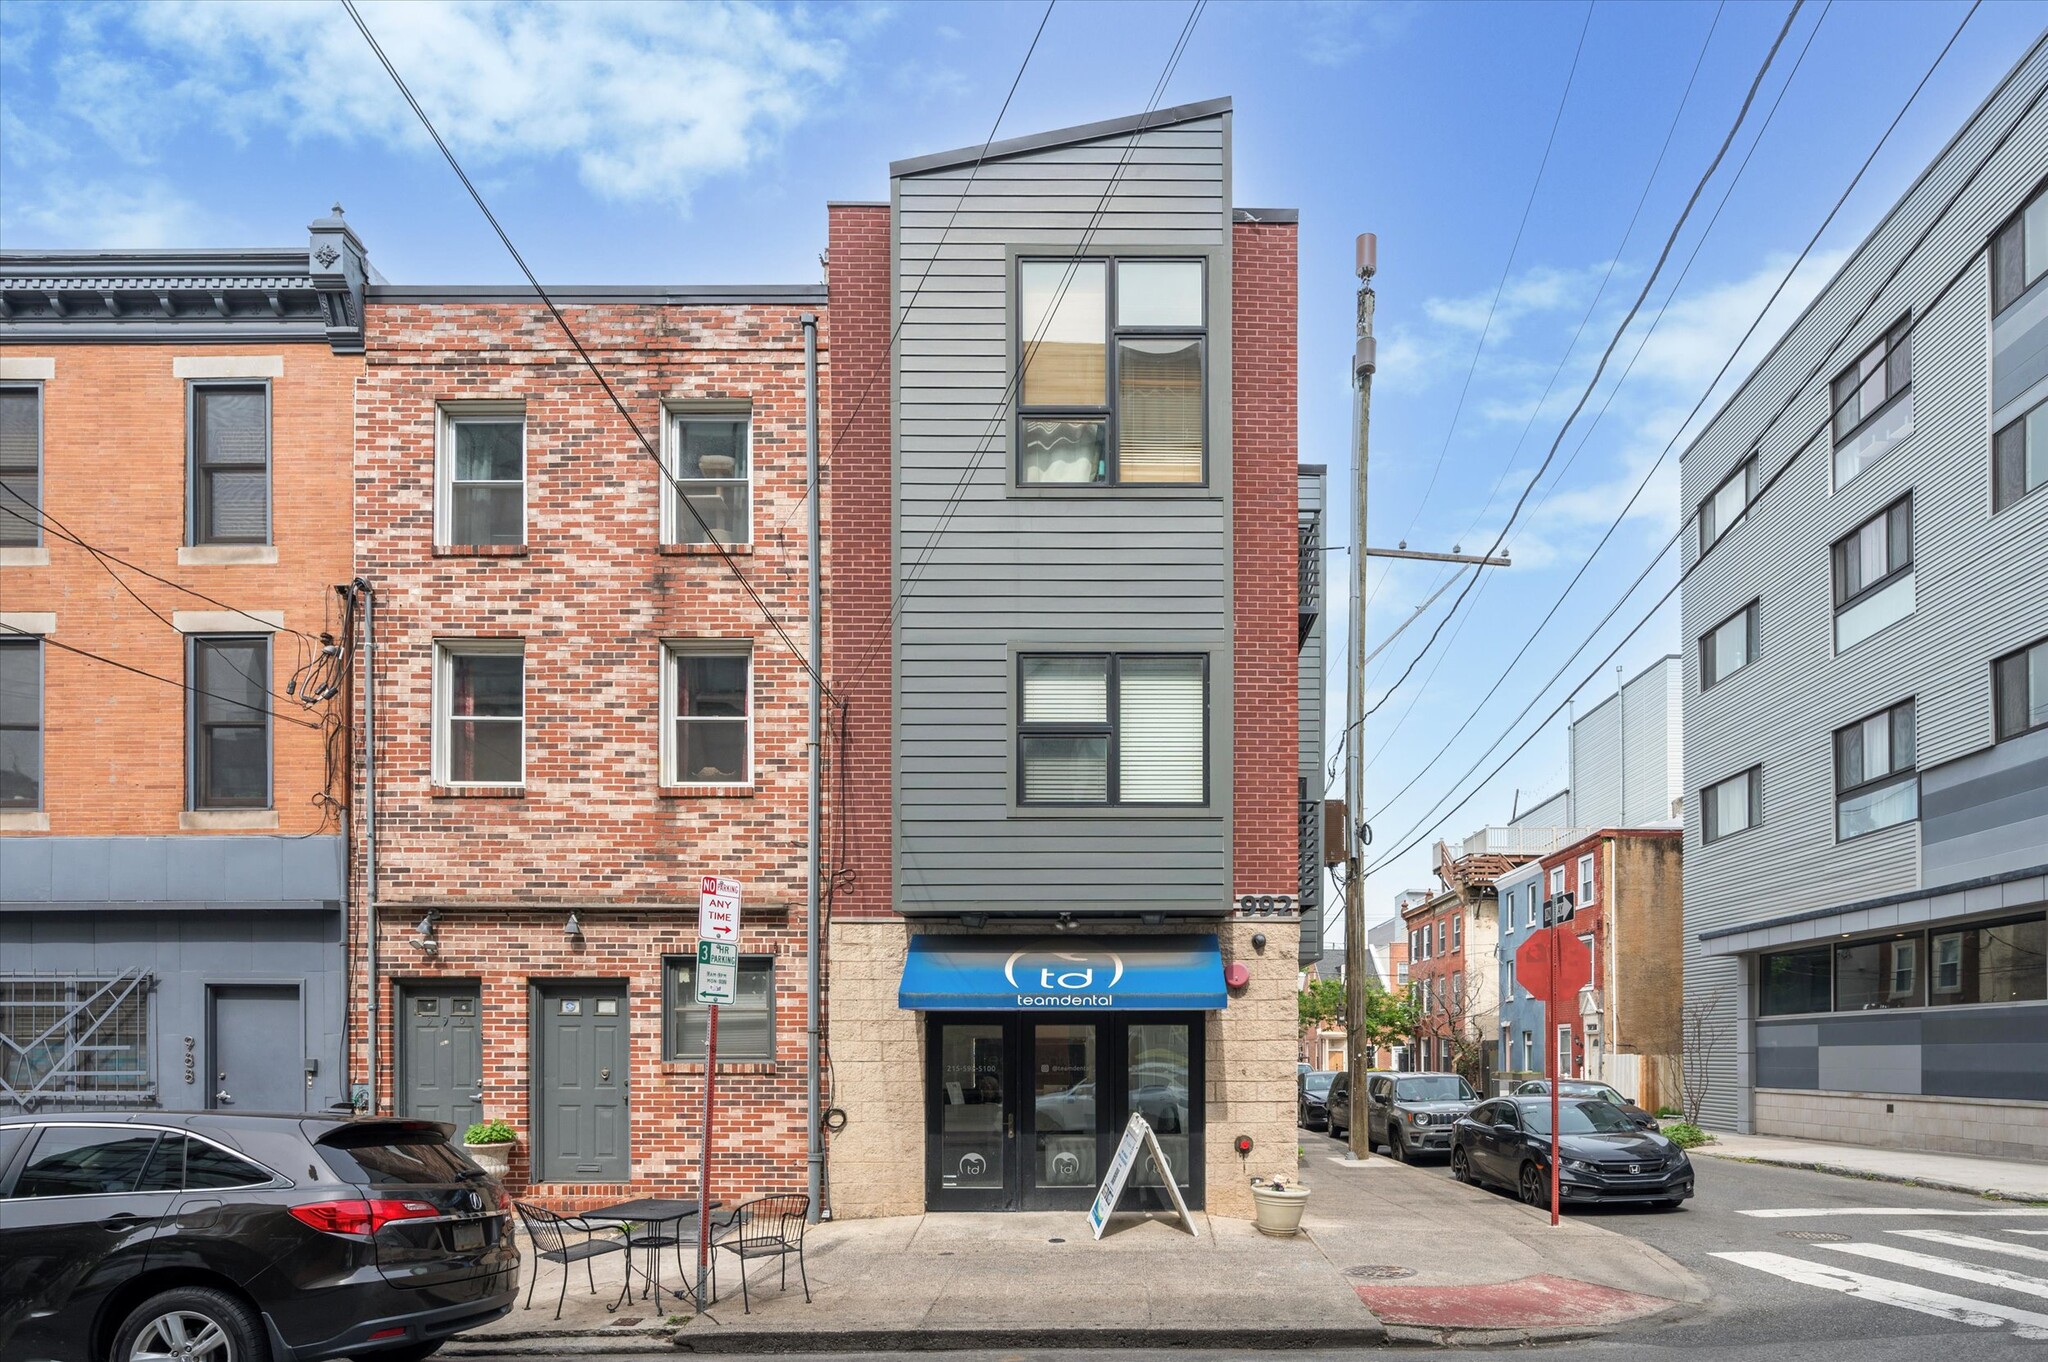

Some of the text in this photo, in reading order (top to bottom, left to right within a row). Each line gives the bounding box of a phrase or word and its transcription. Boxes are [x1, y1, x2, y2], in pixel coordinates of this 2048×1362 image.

[703, 879, 738, 895] NO PARKING
[709, 899, 732, 909] ANY
[1240, 895, 1293, 917] 992
[708, 911, 732, 922] TIME
[701, 945, 730, 960] 3 HR
[711, 954, 735, 965] PARKING
[1040, 968, 1093, 989] td
[1017, 994, 1113, 1006] teamdental
[967, 1165, 980, 1175] td
[1060, 1164, 1073, 1175] td
